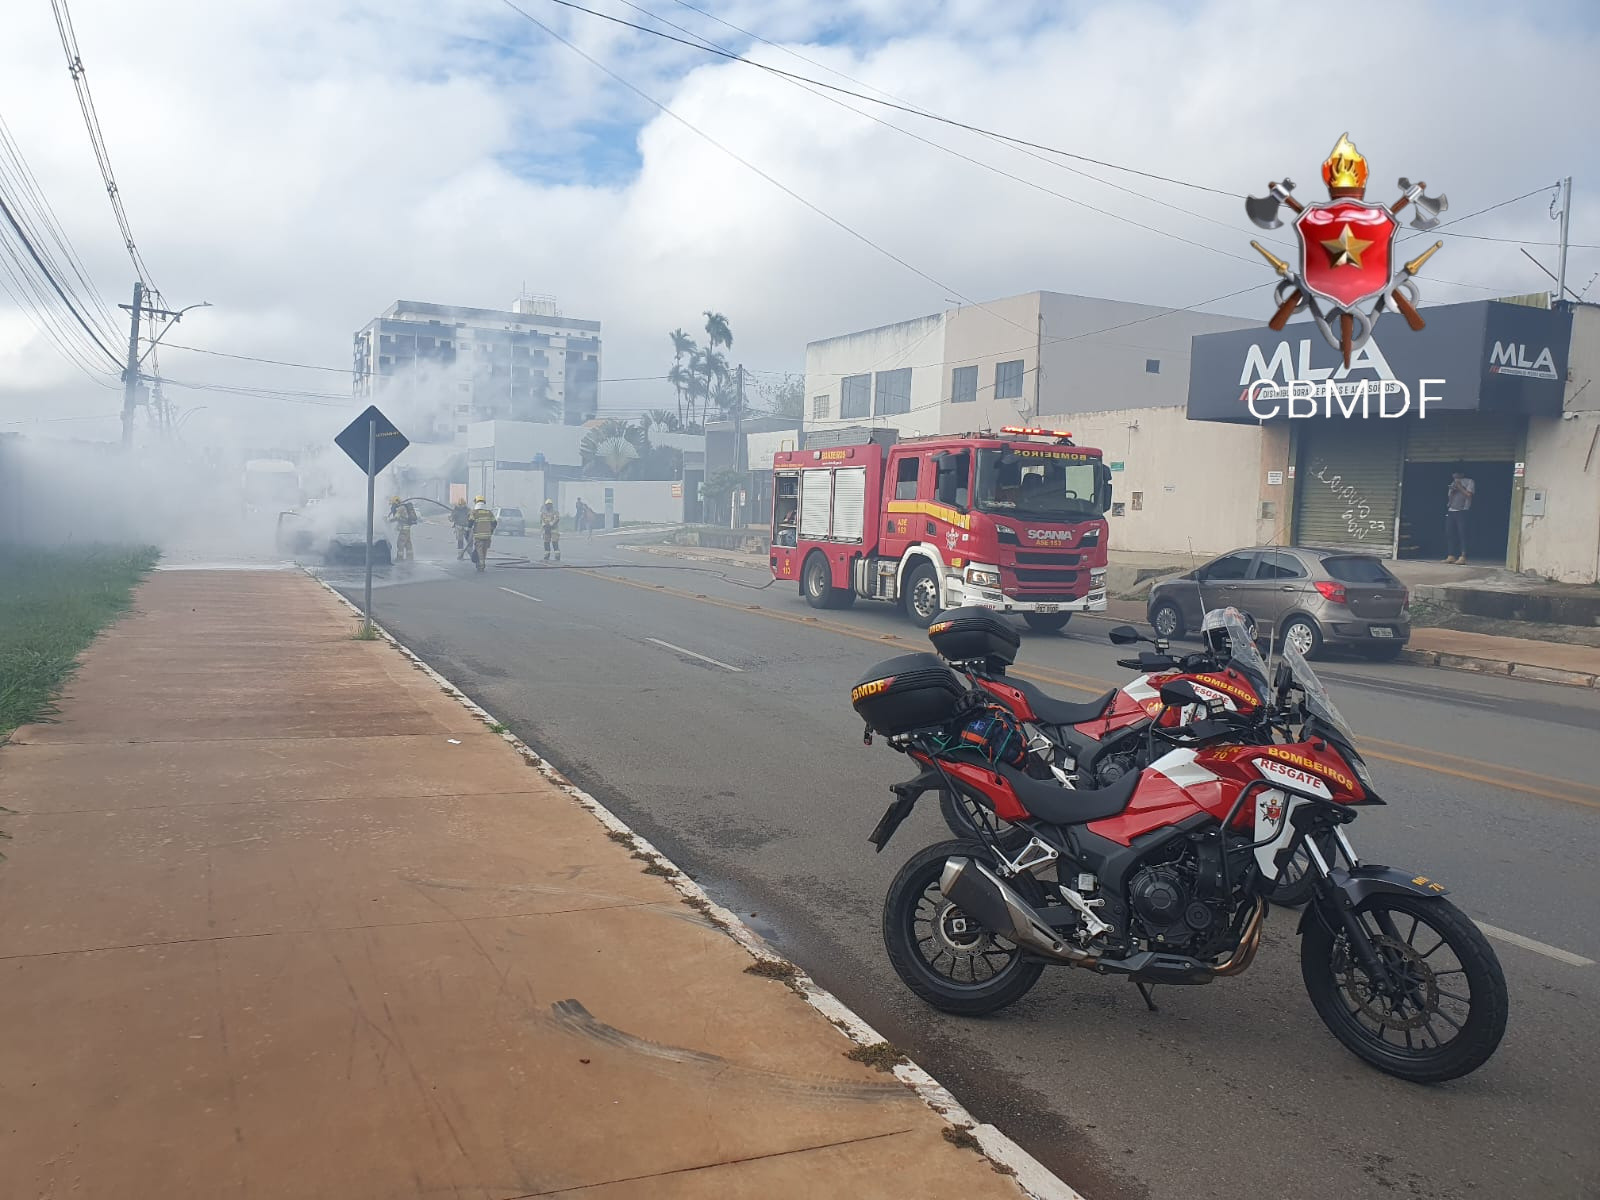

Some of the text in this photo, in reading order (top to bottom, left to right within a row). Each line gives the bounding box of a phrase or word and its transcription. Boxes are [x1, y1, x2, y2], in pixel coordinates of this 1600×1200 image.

[1239, 336, 1399, 386] MLA
[1489, 340, 1558, 380] MLA
[1263, 388, 1310, 398] DISTRIBDORA
[1027, 529, 1073, 541] SCANIA
[852, 679, 885, 702] BMDF
[1190, 683, 1230, 705] ESGATE
[1195, 674, 1259, 707] BOMBEIROS
[1260, 758, 1321, 788] RESGATE
[1268, 746, 1354, 791] BOMBEIROS
